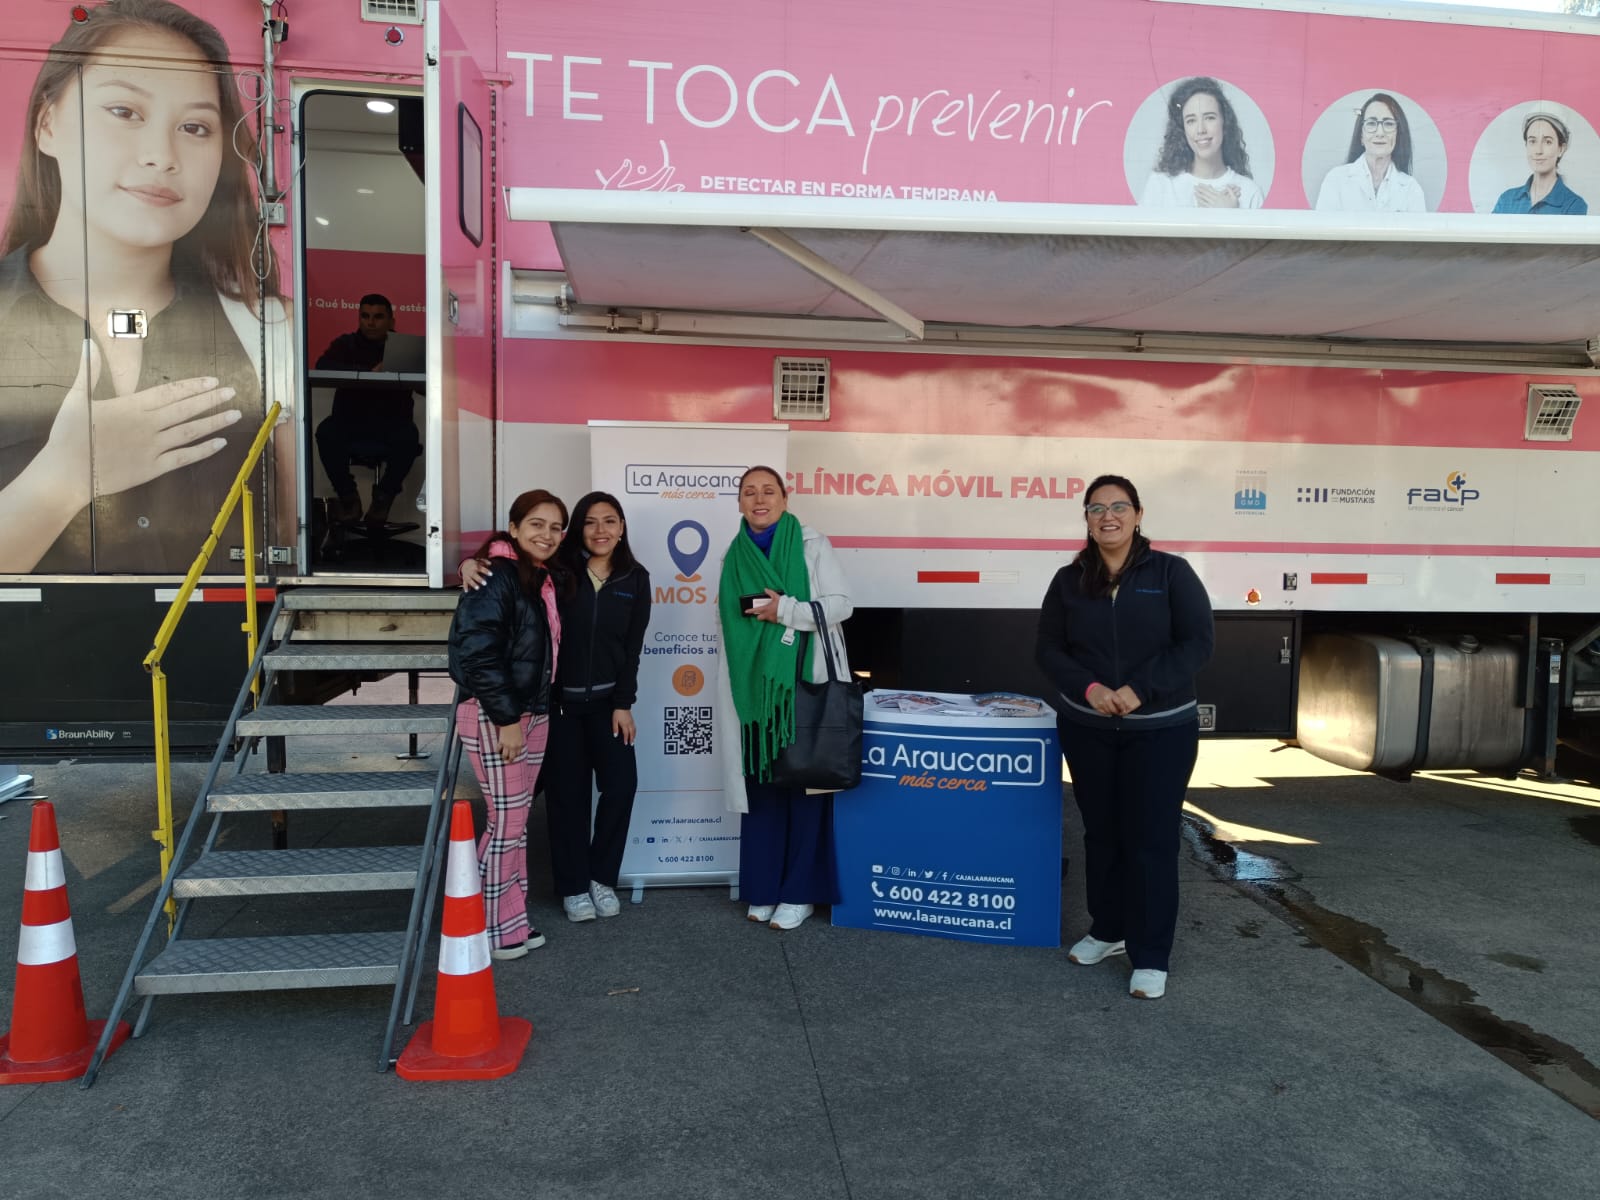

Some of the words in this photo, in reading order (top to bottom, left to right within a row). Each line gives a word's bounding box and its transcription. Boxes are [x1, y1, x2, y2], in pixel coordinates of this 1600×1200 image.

[507, 51, 603, 121] TE
[628, 59, 855, 137] TOCA
[862, 86, 1113, 175] prevenir
[700, 175, 797, 194] DETECTAR
[801, 181, 826, 196] EN
[831, 182, 896, 199] FORMA
[900, 186, 998, 203] TEMPRANA
[341, 298, 361, 310] bue
[632, 471, 652, 487] La
[907, 469, 1003, 498] MÓVIL
[1010, 476, 1086, 499] FALP
[660, 488, 684, 500] más
[685, 489, 716, 500] cerca
[1331, 487, 1376, 496] FUNDACIÓN
[1339, 496, 1376, 504] MUSTAKIS
[652, 586, 707, 604] MOS
[654, 631, 698, 642] Conoce
[702, 632, 718, 642] tus
[643, 644, 704, 655] beneficios
[58, 730, 115, 740] BraunAbility
[862, 745, 885, 766] a
[892, 743, 1033, 774] Araucana
[899, 771, 934, 789] más
[937, 778, 988, 792] cerca
[651, 816, 722, 825] www.laaraucana.cl
[955, 874, 1015, 884] CAJALAARAUCANA
[889, 885, 923, 902] 600
[928, 890, 963, 906] 422
[968, 893, 1015, 910] 8100
[874, 907, 1012, 930] www.laaraucana.cl
